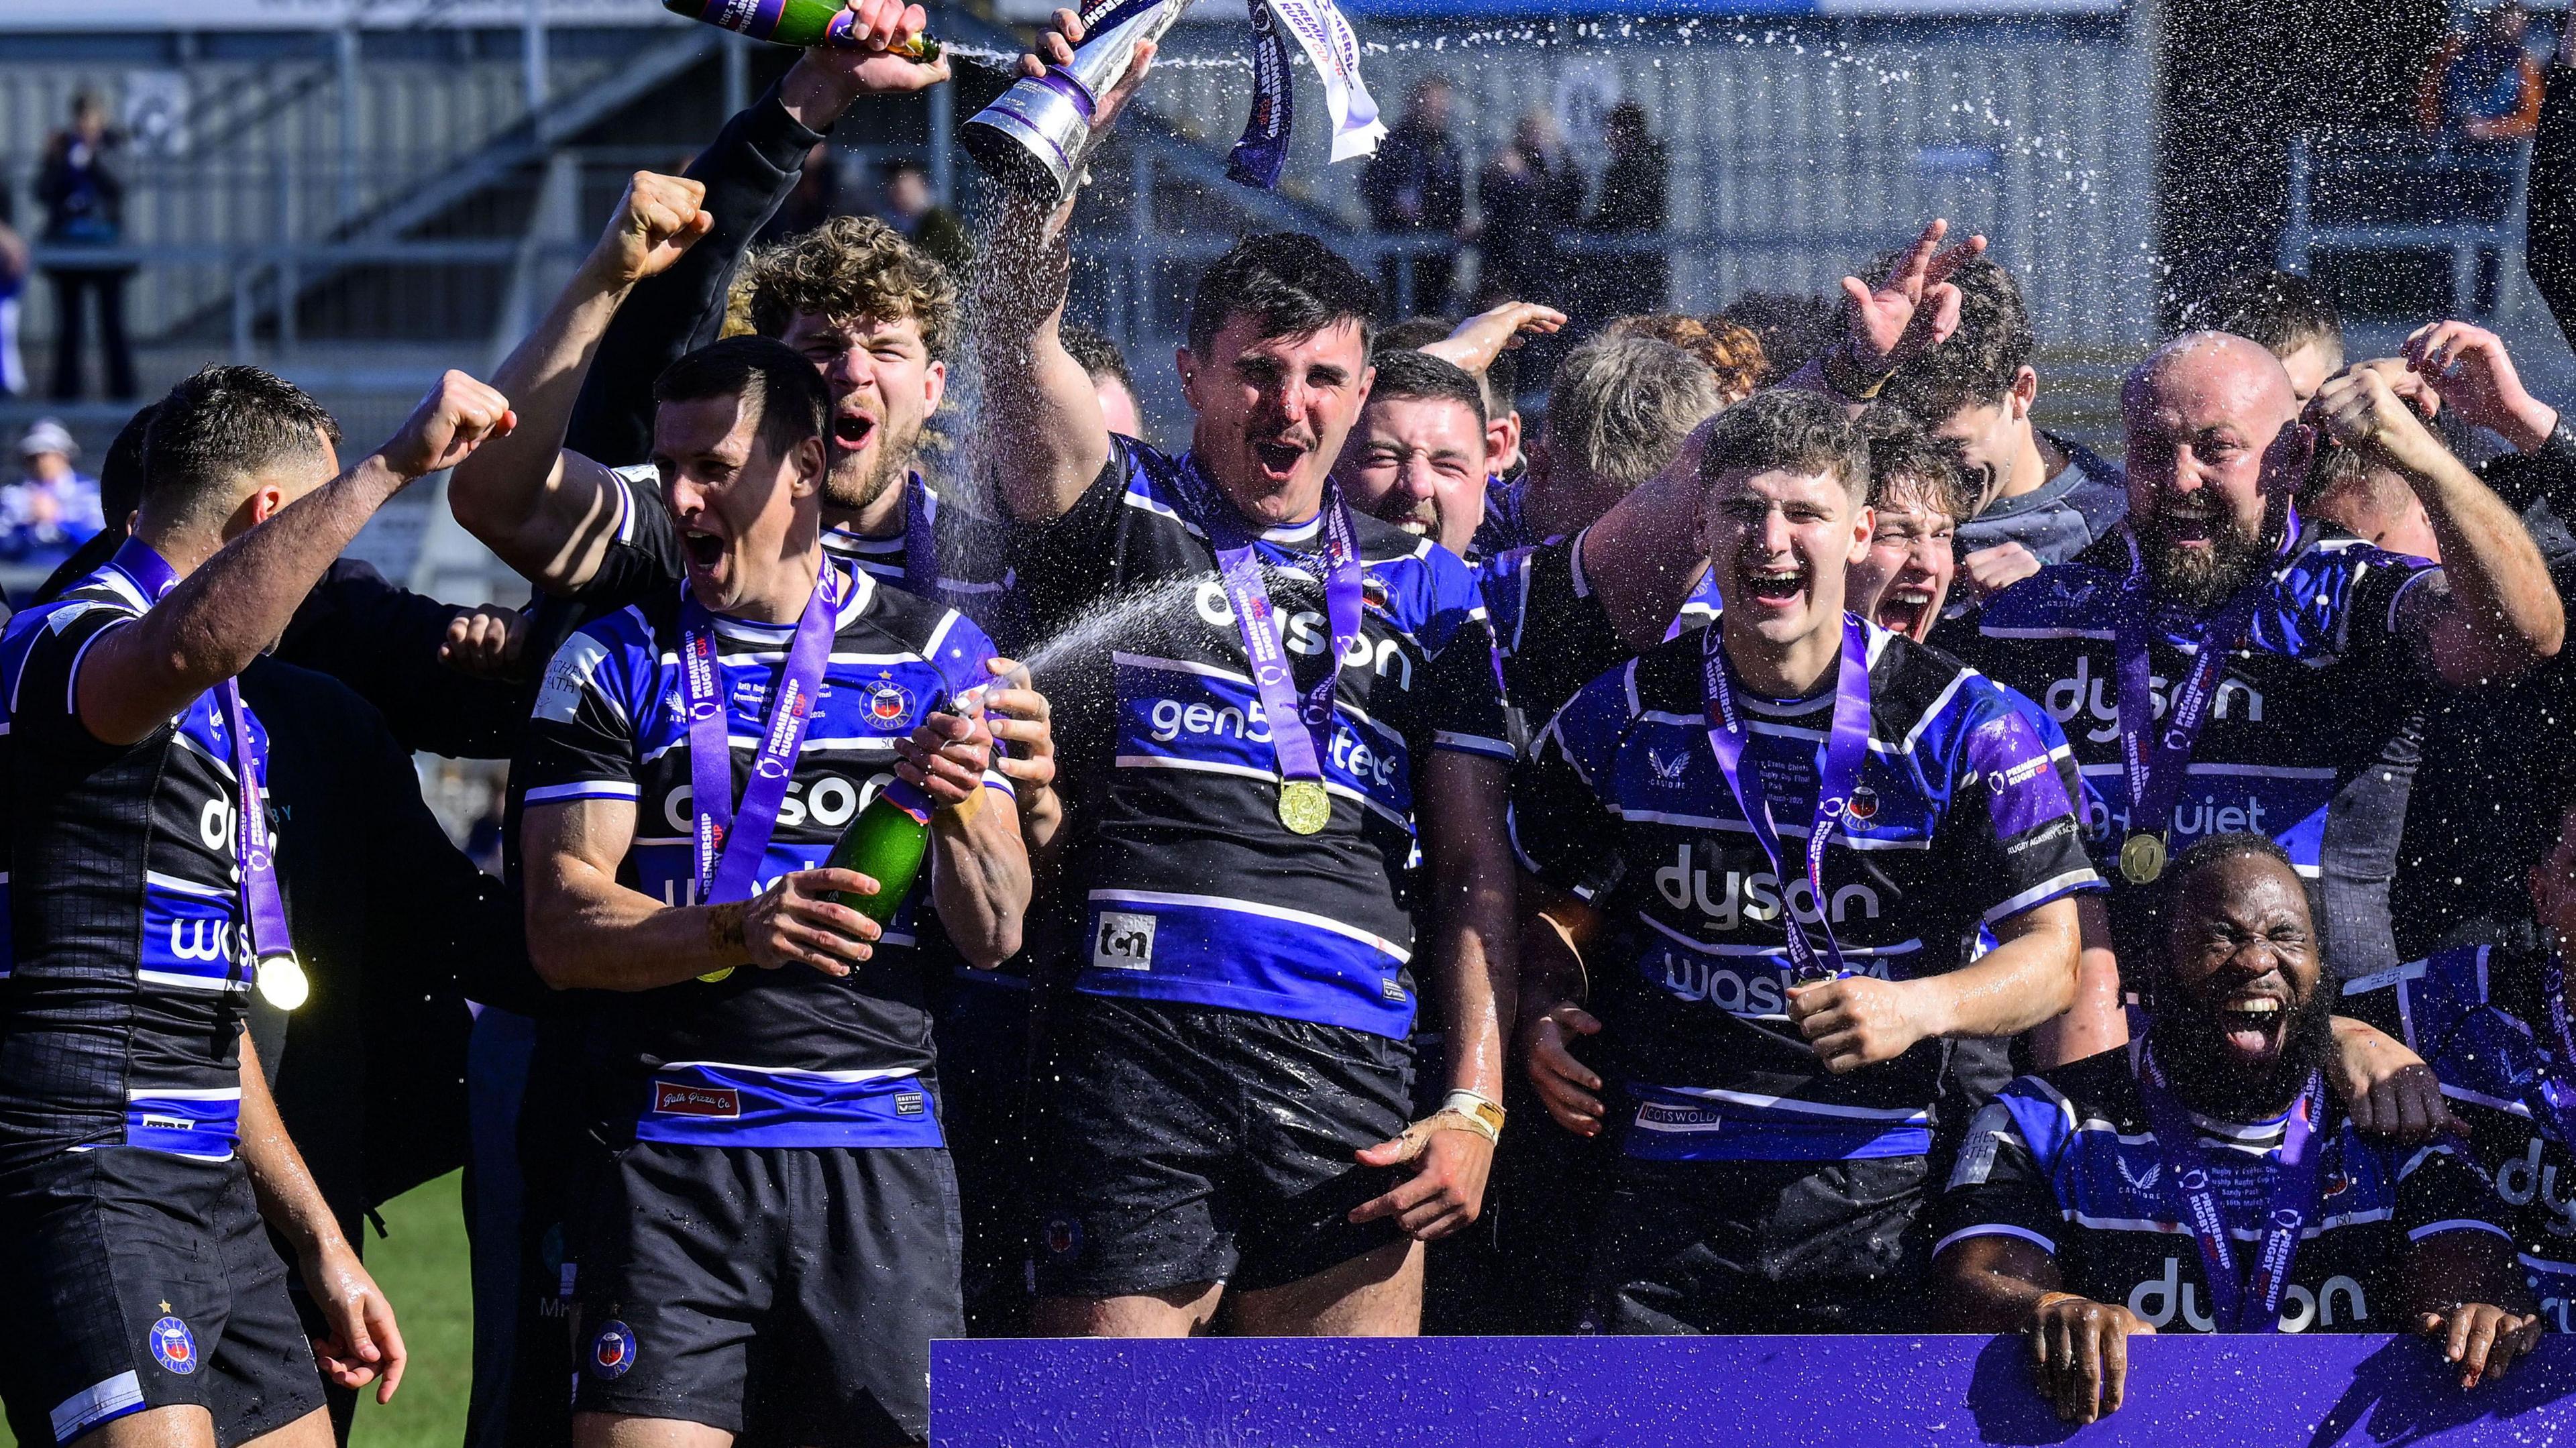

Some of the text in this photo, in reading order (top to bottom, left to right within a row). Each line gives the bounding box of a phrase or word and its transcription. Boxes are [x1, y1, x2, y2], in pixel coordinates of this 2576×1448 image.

[1280, 3, 1316, 40] RUGBY
[1258, 42, 1271, 95] RUGBY
[1267, 34, 1281, 137] PREMIERSHIP
[1334, 502, 1353, 563] PREMIERSHIP
[1236, 588, 1267, 663] PREMIERSHIP
[1258, 621, 1277, 660] RUGBY
[686, 630, 703, 700] PREMIERSHIP
[696, 638, 714, 697] RUGBY CUP
[1706, 662, 1718, 700] RUGBY
[867, 681, 908, 695] BATH
[1713, 656, 1737, 734] PREMIERSHIP
[2176, 653, 2208, 726] PREMIERSHIP
[2184, 689, 2204, 728] RUGBY
[767, 678, 800, 755] PREMIERSHIP
[779, 694, 806, 758] RUGBY CUP
[865, 710, 910, 728] RUGBY
[2008, 768, 2035, 786] RUGBY
[701, 813, 712, 895] PREMIERSHIP
[1811, 820, 1827, 860] RUGBY
[1815, 821, 1834, 899] PREMIERSHIP
[2007, 840, 2029, 855] RUGBY
[1655, 844, 1879, 931] dyson
[170, 918, 253, 967] was
[663, 1092, 731, 1109] Bath Pizza Co
[1647, 1108, 1716, 1123] COTSWOLD
[2118, 1187, 2161, 1200] CASTORE
[2190, 1195, 2211, 1234] RUGBY
[2200, 1192, 2231, 1270] PREMIERSHIP
[2262, 1231, 2279, 1272] RUGBY
[2265, 1233, 2292, 1313] PREMIERSHIP
[154, 1318, 188, 1336] BATH
[160, 1353, 196, 1373] RUGBY
